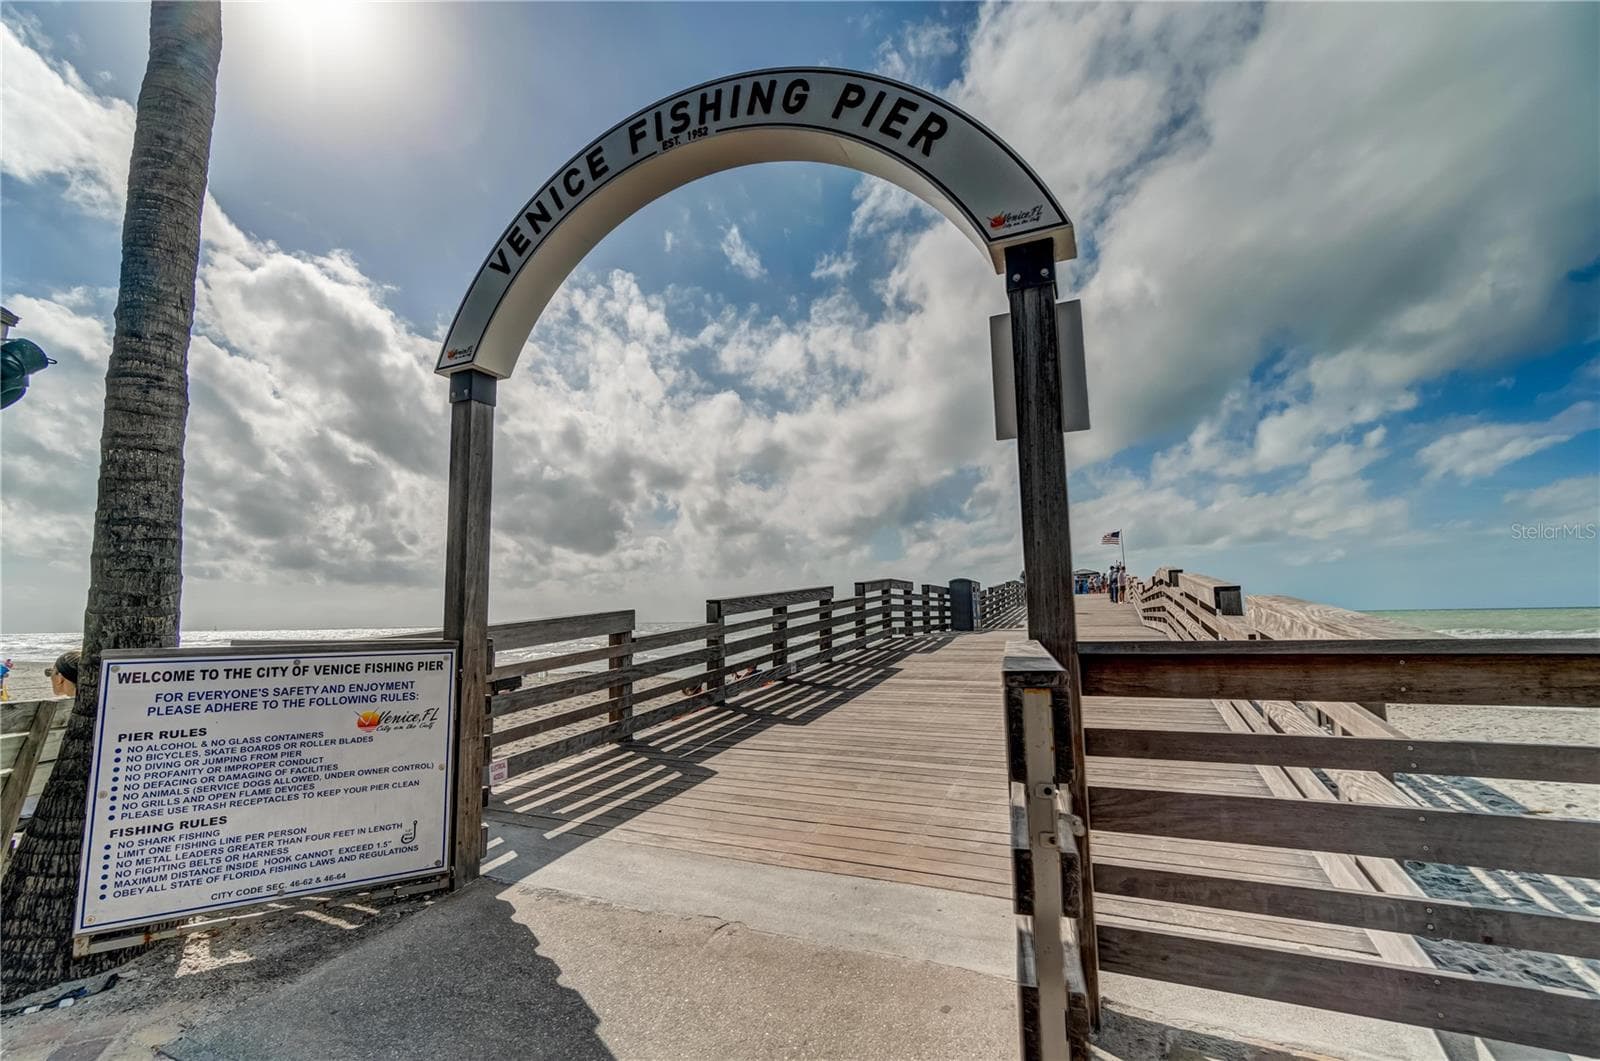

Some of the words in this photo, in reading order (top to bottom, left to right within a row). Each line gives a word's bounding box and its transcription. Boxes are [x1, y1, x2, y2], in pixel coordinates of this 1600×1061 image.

[662, 136, 681, 151] EST.
[688, 126, 708, 141] 1952
[489, 146, 609, 275] VENICE
[628, 78, 810, 155] FISHING
[831, 83, 948, 157] PIER
[117, 670, 196, 684] WELCOME
[199, 669, 220, 680] TO
[222, 668, 253, 679] THE
[256, 666, 289, 678] CITY
[291, 665, 310, 676] OF
[313, 663, 361, 676] VENICE
[364, 661, 414, 673] FISHING
[417, 660, 445, 671] PIER
[147, 704, 201, 716] PLEASE
[204, 701, 259, 713] ADHERE
[261, 700, 279, 710] TO
[281, 698, 306, 708] THE
[309, 694, 378, 707] FOLLOWING
[380, 692, 419, 702] RULES:
[155, 692, 184, 703] FOR
[187, 688, 270, 701] EVERYONE'S
[272, 686, 320, 696] SAFETY
[320, 684, 346, 694] AND
[349, 681, 416, 692] ENJOYMENT
[117, 731, 154, 743] PIER
[159, 728, 208, 739] RULES
[127, 745, 144, 754] NO
[145, 741, 198, 752] ALCOHOL
[200, 740, 208, 748] &
[211, 739, 226, 747] NO
[228, 736, 262, 745] GLASS
[264, 731, 324, 743] CONTAINERS
[125, 764, 142, 772] NO
[144, 761, 182, 771] DIVING
[184, 759, 200, 767] OR
[202, 755, 248, 766] JUMPING
[250, 752, 278, 761] FROM
[280, 750, 302, 759] PIER
[126, 755, 143, 763] NO
[204, 747, 237, 756] SKATE
[240, 743, 281, 753] BOARDS
[283, 742, 297, 750] OR
[299, 739, 337, 748] ROLLER
[339, 736, 374, 745] BLADES
[122, 793, 139, 801] NO
[141, 787, 190, 799] ANIMALS
[192, 782, 240, 794] (SERVICE
[242, 779, 272, 789] DOGS
[324, 770, 357, 780] UNDER
[357, 767, 390, 777] OWNER
[391, 762, 434, 773] CONTROL)
[124, 773, 141, 782] NO
[144, 768, 204, 780] PROFANITY
[206, 766, 222, 774] OR
[224, 761, 277, 772] IMPROPER
[278, 757, 324, 767] CONDUCT
[124, 783, 140, 791] NO
[143, 777, 198, 790] DEFACING
[200, 776, 215, 784] OR
[218, 770, 272, 782] DAMAGING
[290, 764, 339, 775] FACILITIES
[121, 808, 164, 820] PLEASE
[167, 806, 189, 815] USE
[191, 801, 227, 812] TRASH
[229, 793, 300, 808] RECEPTACLES
[316, 789, 341, 798] KEEP
[343, 786, 368, 795] YOUR
[370, 783, 390, 792] PIER
[391, 780, 421, 789] CLEAN
[122, 802, 138, 810] NO
[141, 797, 181, 808] GRILLS
[183, 795, 205, 804] AND
[208, 791, 236, 801] OPEN
[239, 787, 272, 798] FLAME
[275, 783, 315, 794] DEVICES
[109, 822, 175, 839] FISHING
[179, 815, 228, 830] RULES
[118, 840, 135, 849] NO
[138, 835, 176, 847] SHARK
[179, 830, 220, 841] FISHING
[116, 859, 133, 869] NO
[136, 854, 172, 866] METAL
[175, 847, 224, 861] LEADERS
[227, 840, 274, 853] GREATER
[276, 836, 303, 846] THAN
[305, 832, 331, 842] FOUR
[333, 829, 355, 838] FEET
[357, 827, 366, 835] IN
[368, 822, 403, 833] LENGTH
[117, 848, 146, 859] LIMIT
[148, 845, 171, 855] ONE
[175, 839, 217, 851] FISHING
[219, 835, 242, 845] LINE
[245, 832, 265, 842] PER
[267, 827, 307, 839] PERSON
[113, 886, 145, 898] OBEY
[146, 883, 167, 893] ALL
[170, 877, 203, 889] STATE
[206, 875, 220, 884] OF
[223, 868, 267, 881] FLORIDA
[269, 861, 307, 874] FISHING
[309, 857, 336, 868] LAWS
[337, 854, 357, 863] AND
[358, 844, 419, 860] REGULATIONS
[114, 873, 168, 889] MAXIMUM
[171, 865, 223, 880] DISTANCE
[225, 860, 258, 872] INSIDE
[264, 855, 292, 866] HOOK
[294, 849, 334, 862] CANNOT
[338, 843, 374, 855] EXCEED
[115, 869, 131, 879] NO
[135, 862, 186, 876] FIGHTING
[189, 857, 222, 868] BELTS
[225, 854, 239, 863] OR
[243, 847, 289, 860] HARNESS
[211, 890, 233, 901] CITY
[236, 885, 264, 897] CODE
[315, 876, 321, 884] &
